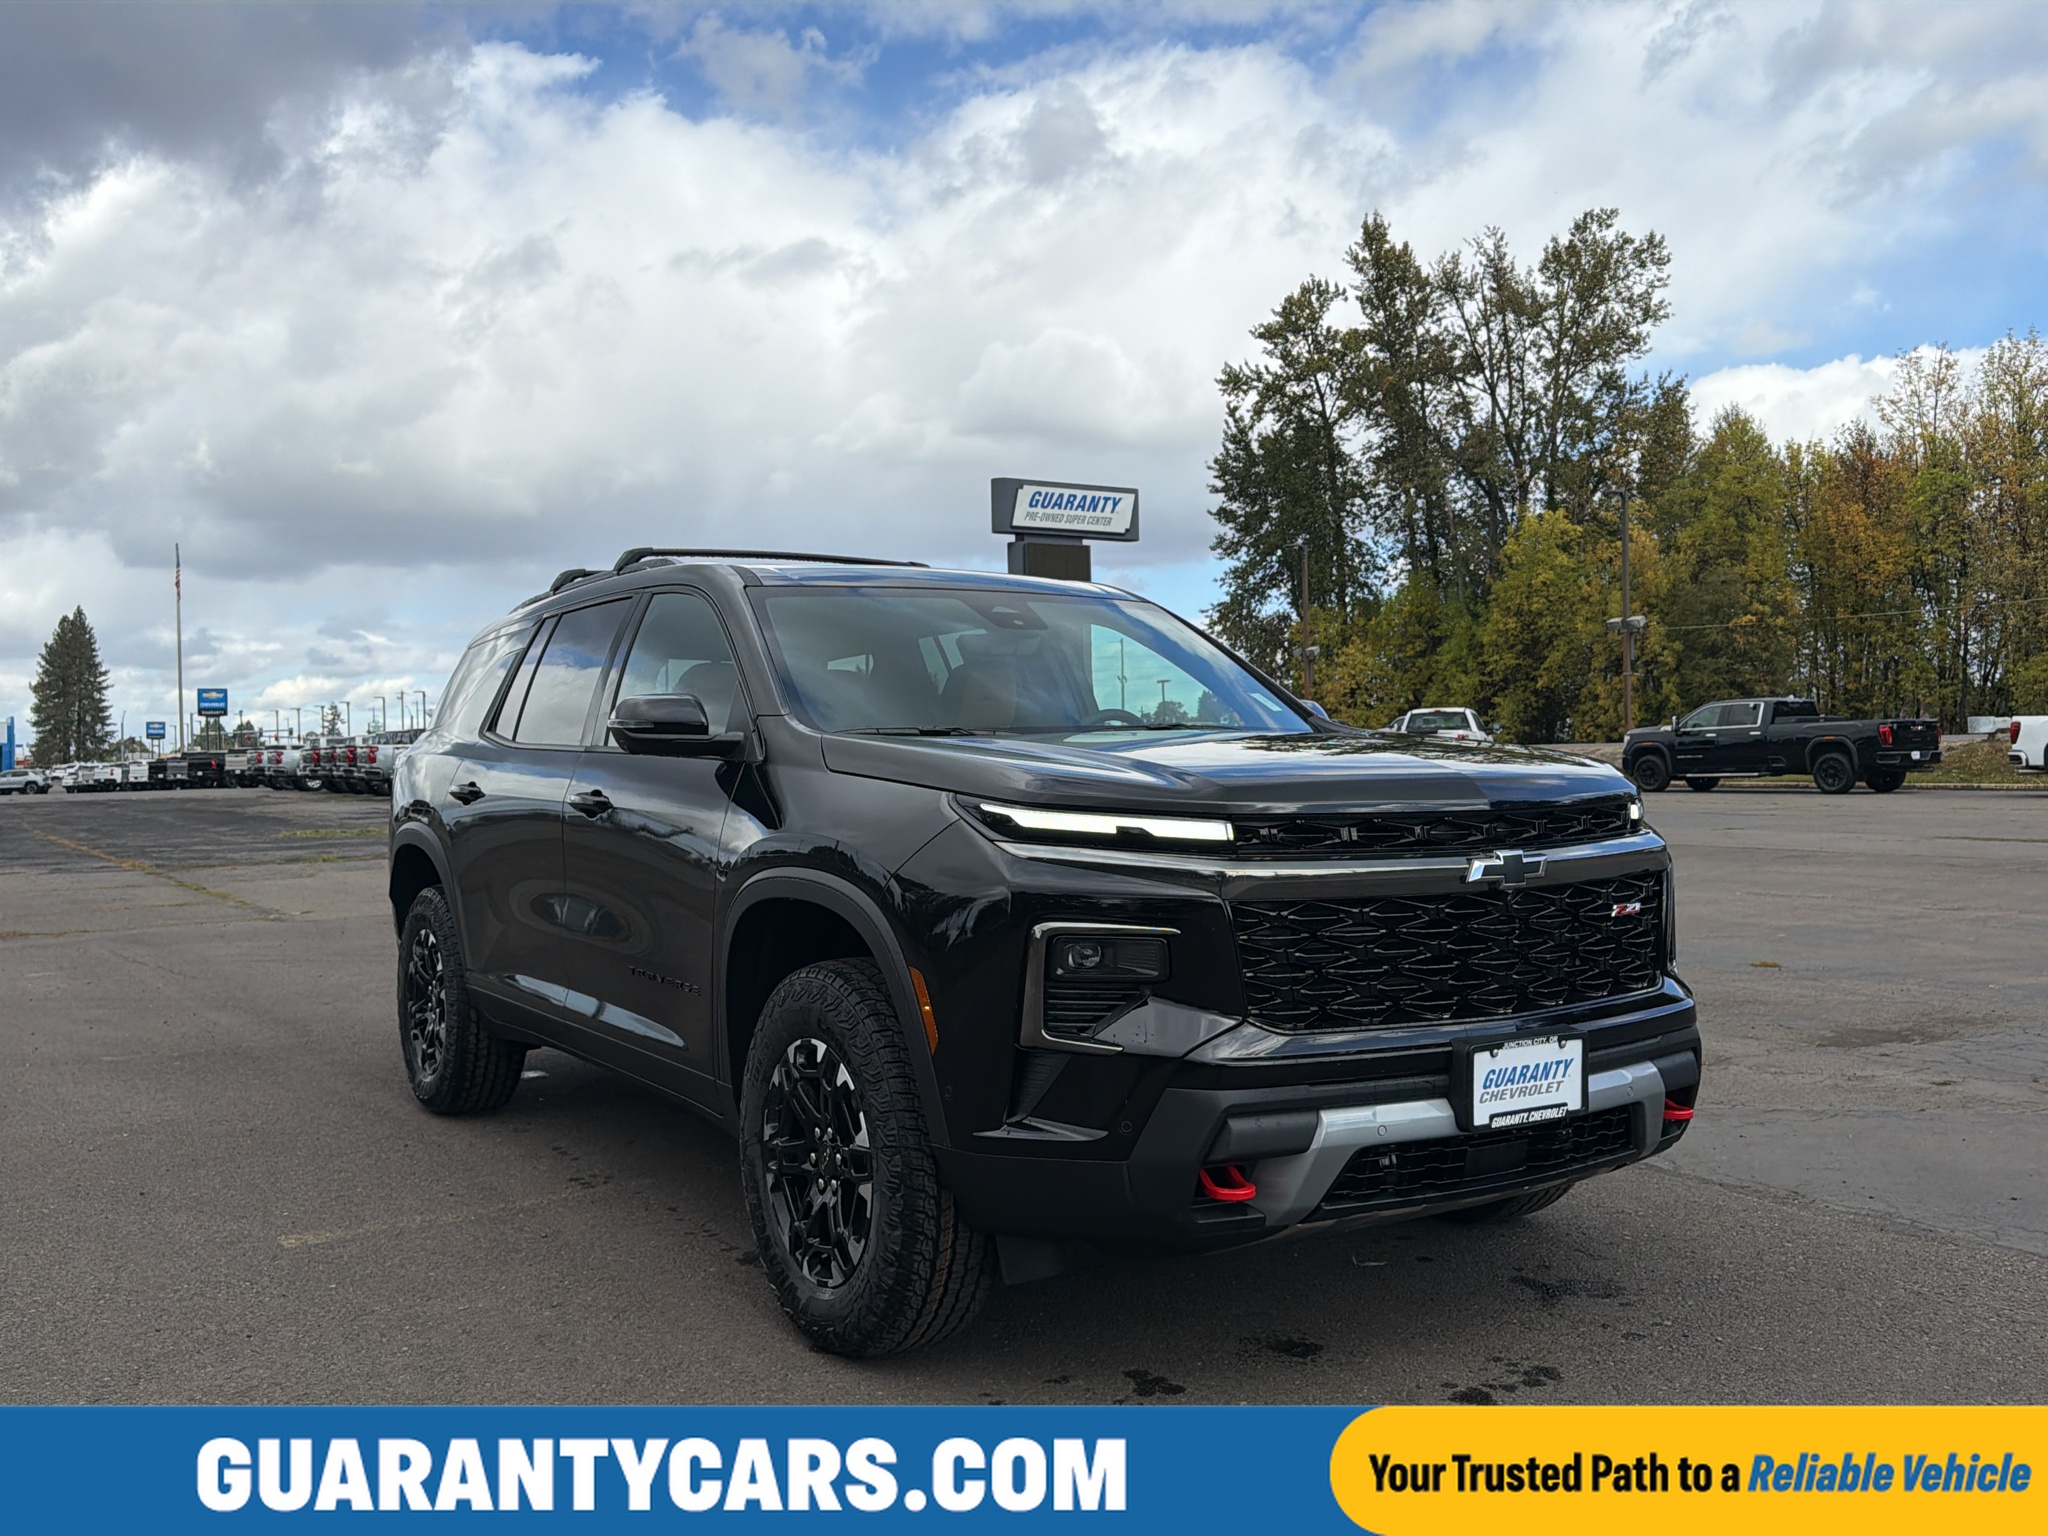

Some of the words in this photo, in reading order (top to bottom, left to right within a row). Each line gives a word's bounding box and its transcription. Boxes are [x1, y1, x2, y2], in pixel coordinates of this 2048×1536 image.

[1028, 490, 1123, 514] GUARANTY
[1024, 511, 1065, 523] PRE-OWNED
[1064, 513, 1087, 525] SUPER
[1086, 515, 1112, 526] CENTER
[1502, 1038, 1533, 1050] JUNCTION
[1549, 1035, 1559, 1044] OR
[1482, 1058, 1575, 1090] GUARANTY
[1479, 1080, 1565, 1104] CHEVROLET
[1528, 1106, 1569, 1122] CHEVROLET
